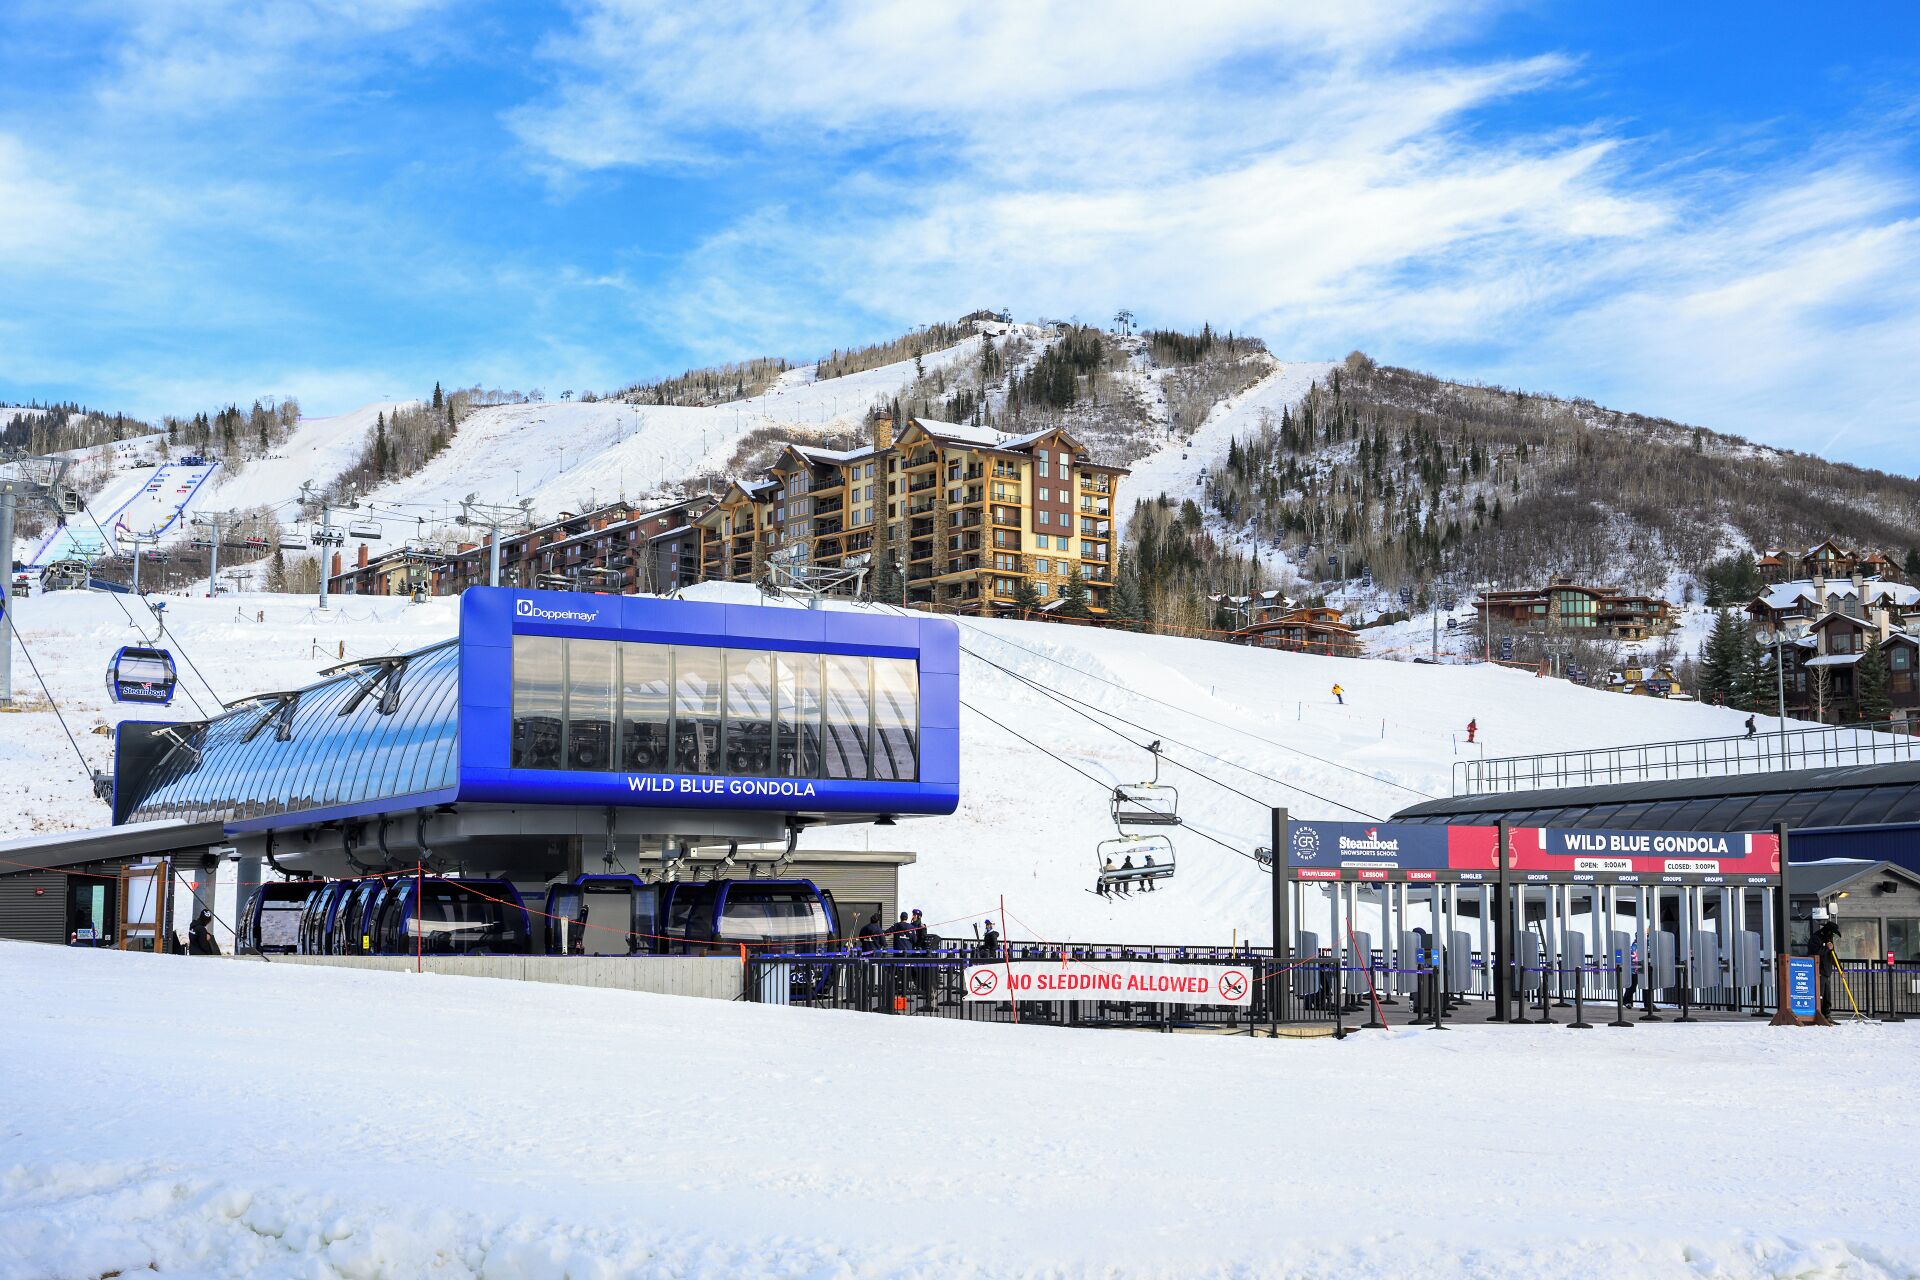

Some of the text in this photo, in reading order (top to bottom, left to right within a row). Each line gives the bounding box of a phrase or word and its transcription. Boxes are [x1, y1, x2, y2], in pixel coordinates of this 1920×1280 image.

[533, 607, 597, 623] Doppelmayr
[123, 685, 167, 697] Steamboat
[627, 776, 816, 797] WILD BLUE GONDOLA
[1339, 831, 1399, 850] Steamboat
[1564, 833, 1729, 853] WILD BLUE GONDOLA
[1580, 861, 1627, 869] OPEN: 9:00AM
[1667, 862, 1692, 870] CLOSED:
[1006, 974, 1209, 993] NO SLEDDING ALLOWED
